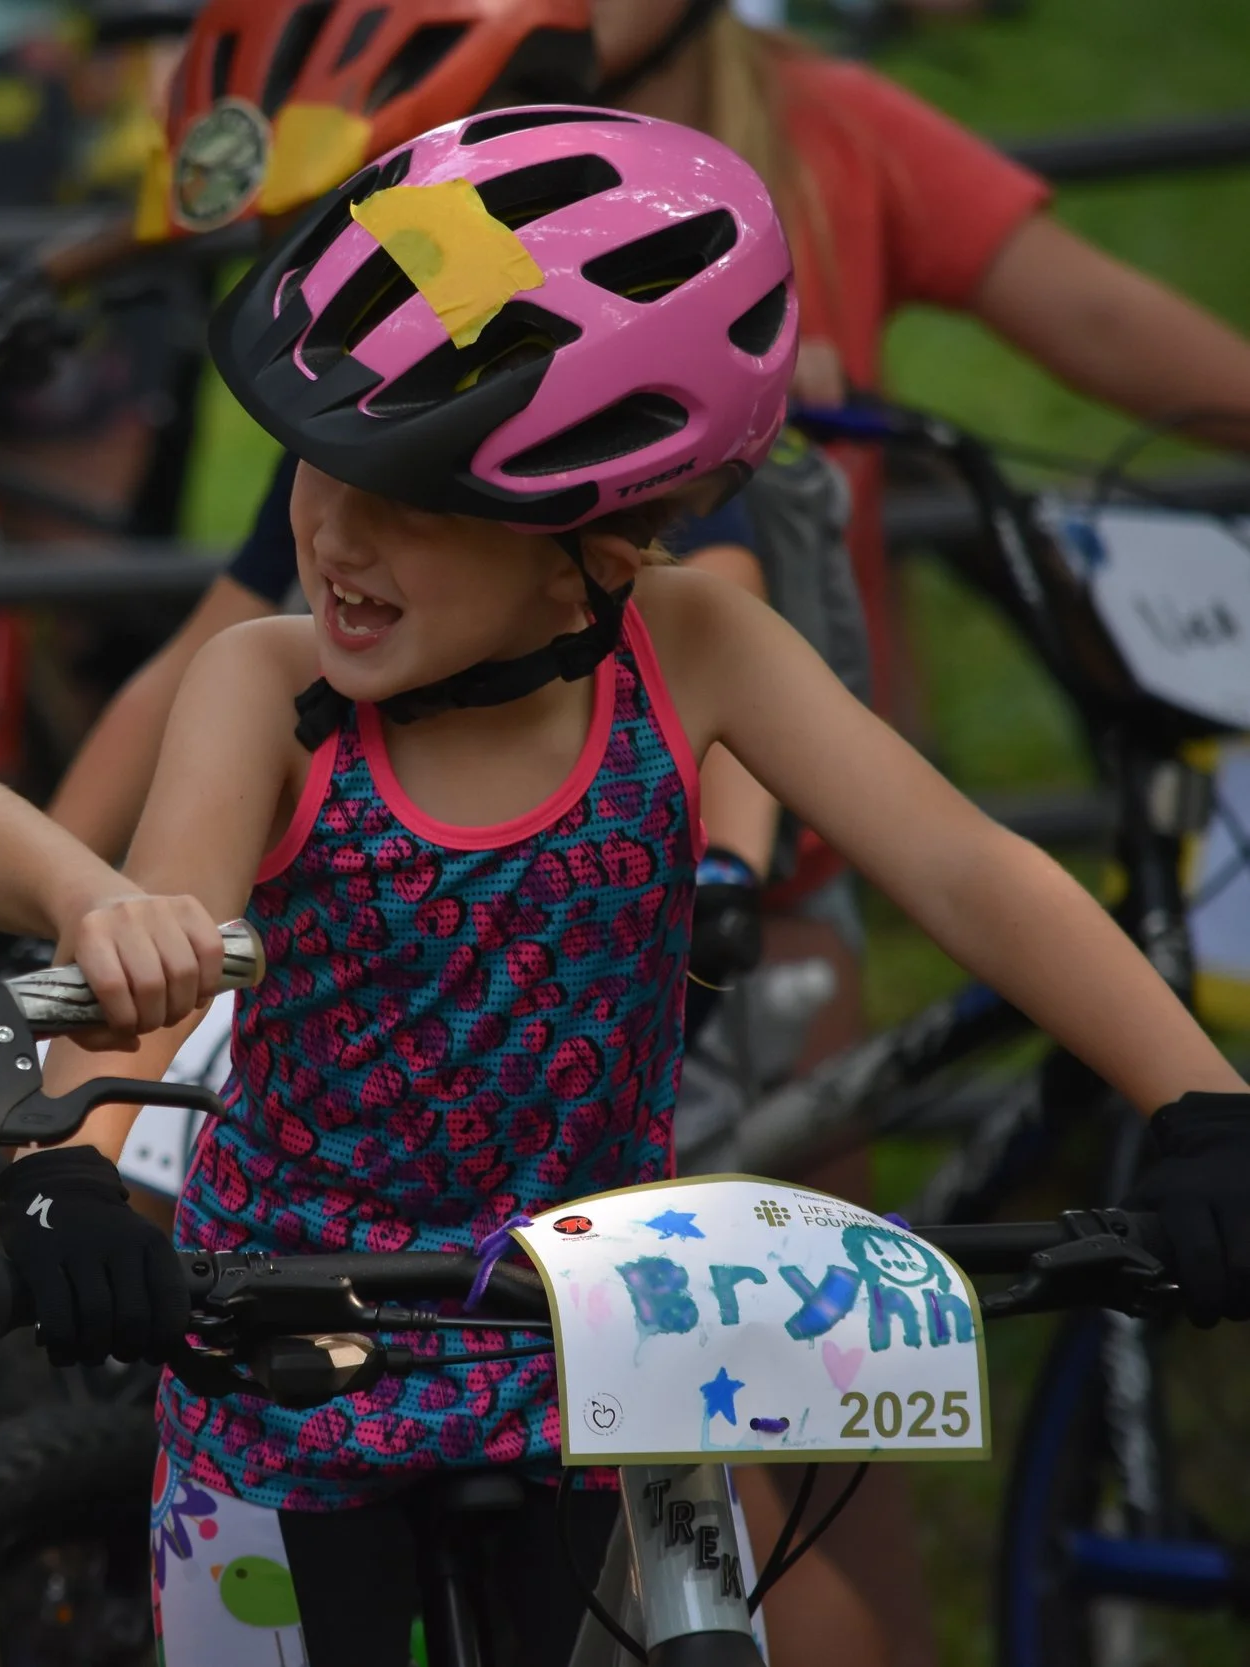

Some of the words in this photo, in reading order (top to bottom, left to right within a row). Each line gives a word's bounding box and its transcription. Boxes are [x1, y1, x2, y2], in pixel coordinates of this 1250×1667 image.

[616, 456, 698, 498] TREK
[798, 1203, 835, 1217] LIFE
[839, 1209, 881, 1226] TIME
[615, 1256, 974, 1352] Brynn
[839, 1391, 971, 1439] 2025
[643, 1478, 743, 1601] TREK
